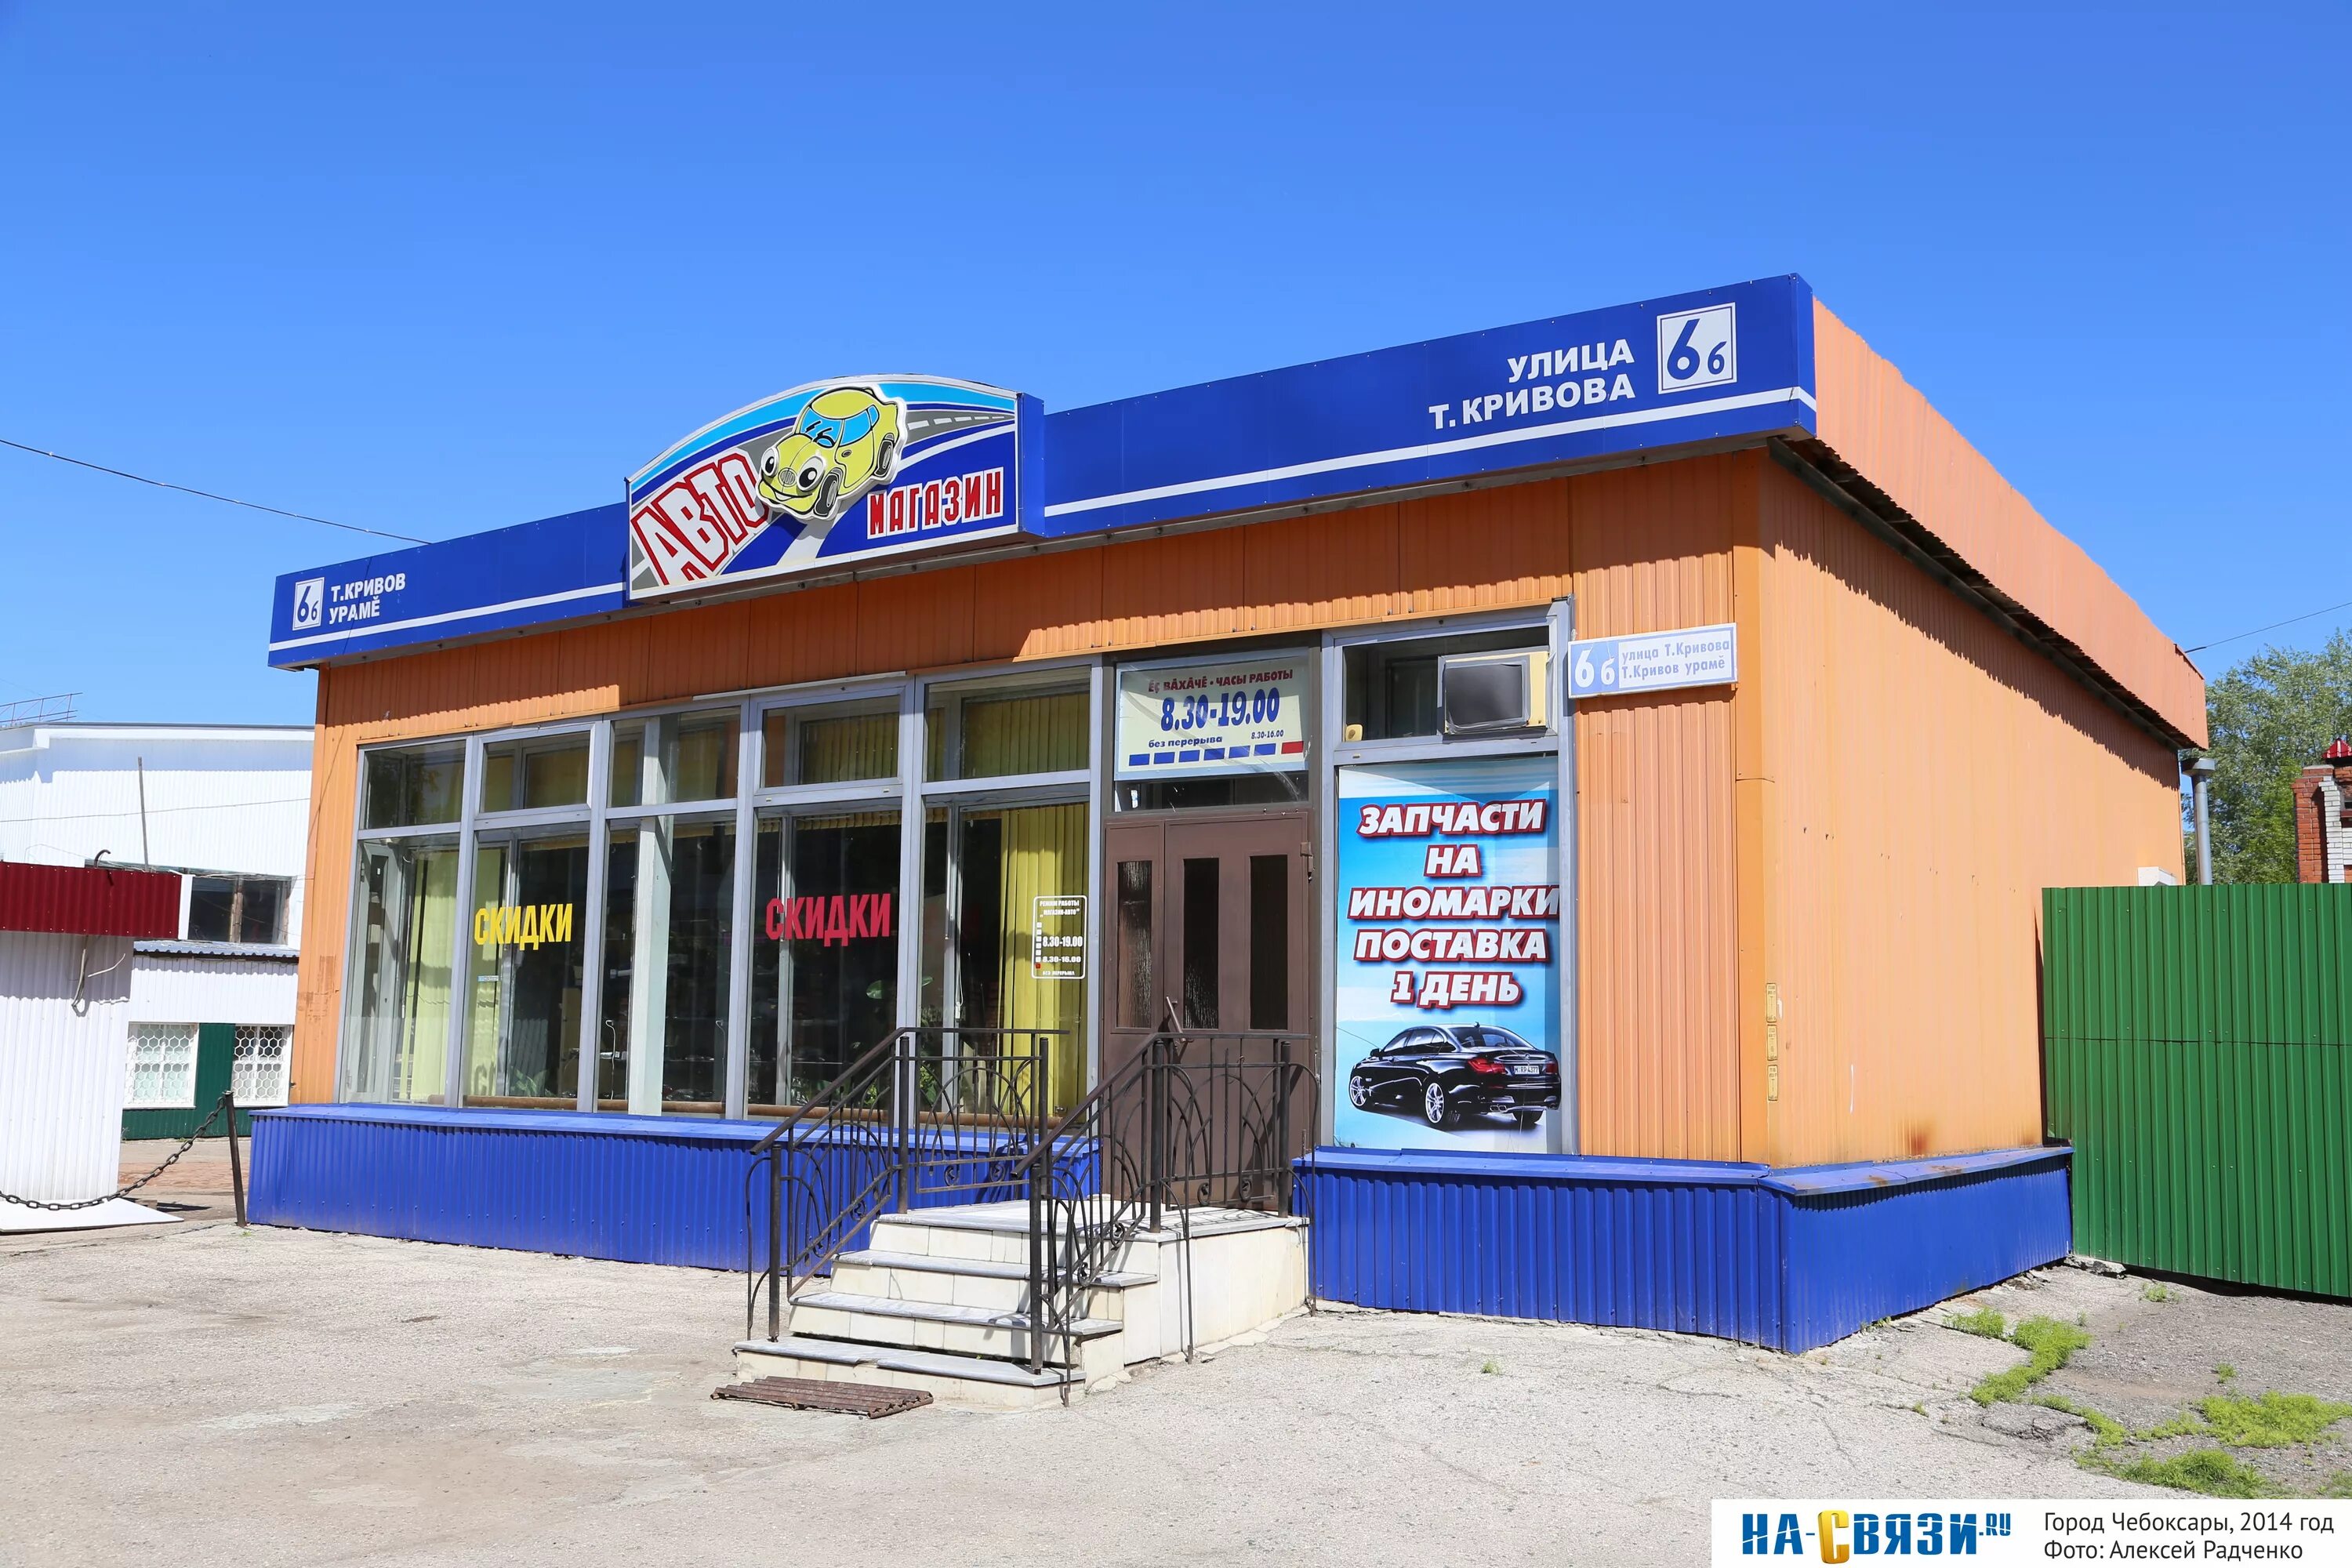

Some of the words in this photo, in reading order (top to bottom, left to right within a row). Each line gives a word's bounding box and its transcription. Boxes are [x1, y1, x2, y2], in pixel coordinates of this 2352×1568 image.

[1507, 339, 1635, 383] УЛИЦА
[630, 448, 770, 586] АВТО
[868, 467, 1004, 538] МАГАЗИН
[331, 572, 406, 603] Т.КРИВОВ
[1622, 648, 1659, 665] улица
[1664, 639, 1730, 657] Т.Кривова
[1216, 673, 1247, 687] ЧАСЫ
[1249, 670, 1294, 684] РАБОТЫ
[1621, 664, 1679, 681] Т.Кривов
[1160, 687, 1280, 731] 8.30-19.00
[1149, 739, 1166, 748] без
[1168, 736, 1223, 748] перерыва
[1250, 729, 1284, 740] 8.30-16.00
[1356, 800, 1545, 836] ЗАПЧАСТИ
[1425, 845, 1481, 876] НА
[1348, 886, 1559, 919] ИНОМАРКИ
[474, 903, 572, 950] СКИДКИ
[765, 893, 891, 947] СКИДКИ
[1042, 936, 1083, 947] 8.30-19.00
[1354, 929, 1548, 961] ПОСТАВКА
[1391, 972, 1414, 1002] 1
[1417, 973, 1521, 1007] ДЕНЬ
